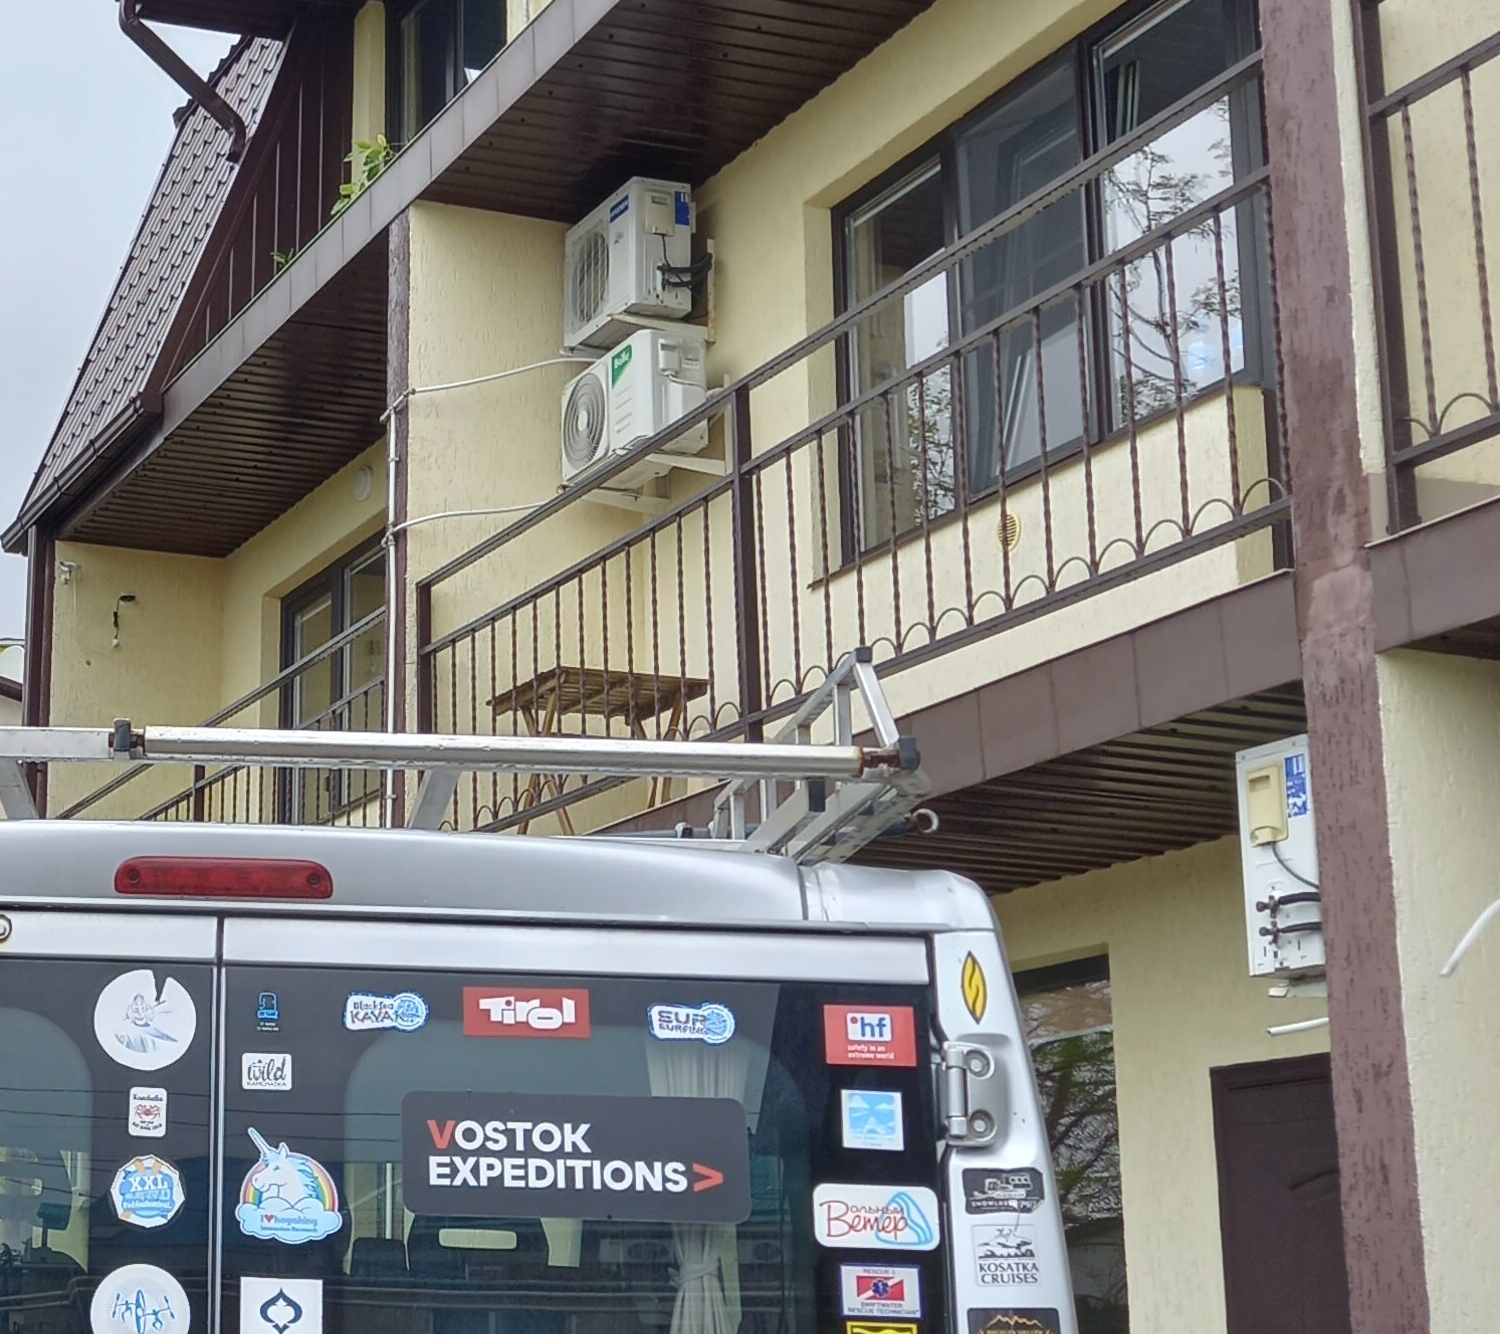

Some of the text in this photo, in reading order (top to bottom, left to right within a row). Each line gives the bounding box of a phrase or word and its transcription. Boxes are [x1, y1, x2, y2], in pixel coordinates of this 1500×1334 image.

[350, 1010, 405, 1024] KAYAK
[479, 996, 575, 1030] Tirol
[658, 1010, 707, 1026] SUP
[876, 1052, 894, 1060] world
[247, 1056, 287, 1081] wild
[427, 1119, 591, 1154] VOSTOK
[428, 1156, 688, 1193] EXPEDITIONS
[129, 1175, 168, 1192] XXL
[979, 1262, 1040, 1273] KOSATKA
[981, 1273, 1038, 1284] CRUISES
